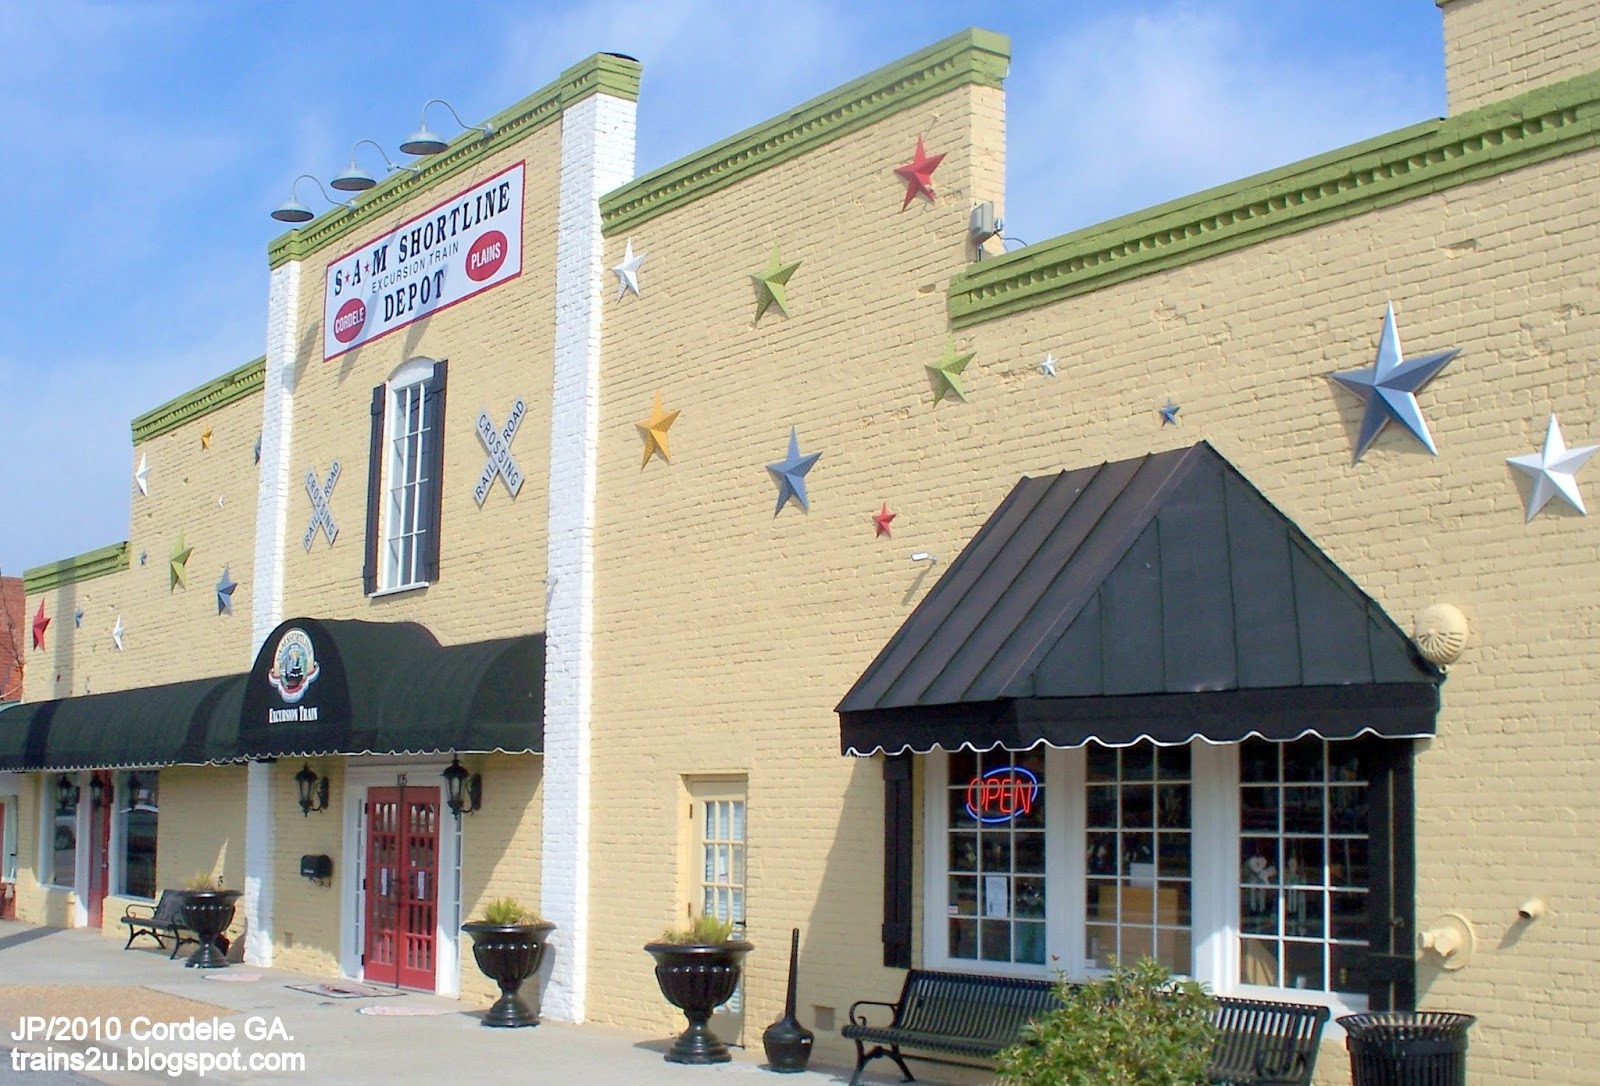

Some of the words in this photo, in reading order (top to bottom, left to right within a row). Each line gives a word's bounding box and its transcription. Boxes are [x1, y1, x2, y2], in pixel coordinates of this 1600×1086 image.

[398, 181, 510, 264] SHORTLINE
[371, 258, 426, 294] EXCURSION
[429, 241, 459, 265] TRAIN
[471, 241, 502, 270] PLAINS
[334, 306, 365, 334] CORDELE
[383, 269, 445, 323] DEPOT
[475, 463, 497, 501] RAIL
[502, 399, 524, 444] ROAD
[477, 413, 519, 487] CROSSING
[306, 472, 335, 537] CROSSING
[967, 777, 1034, 814] OPEN
